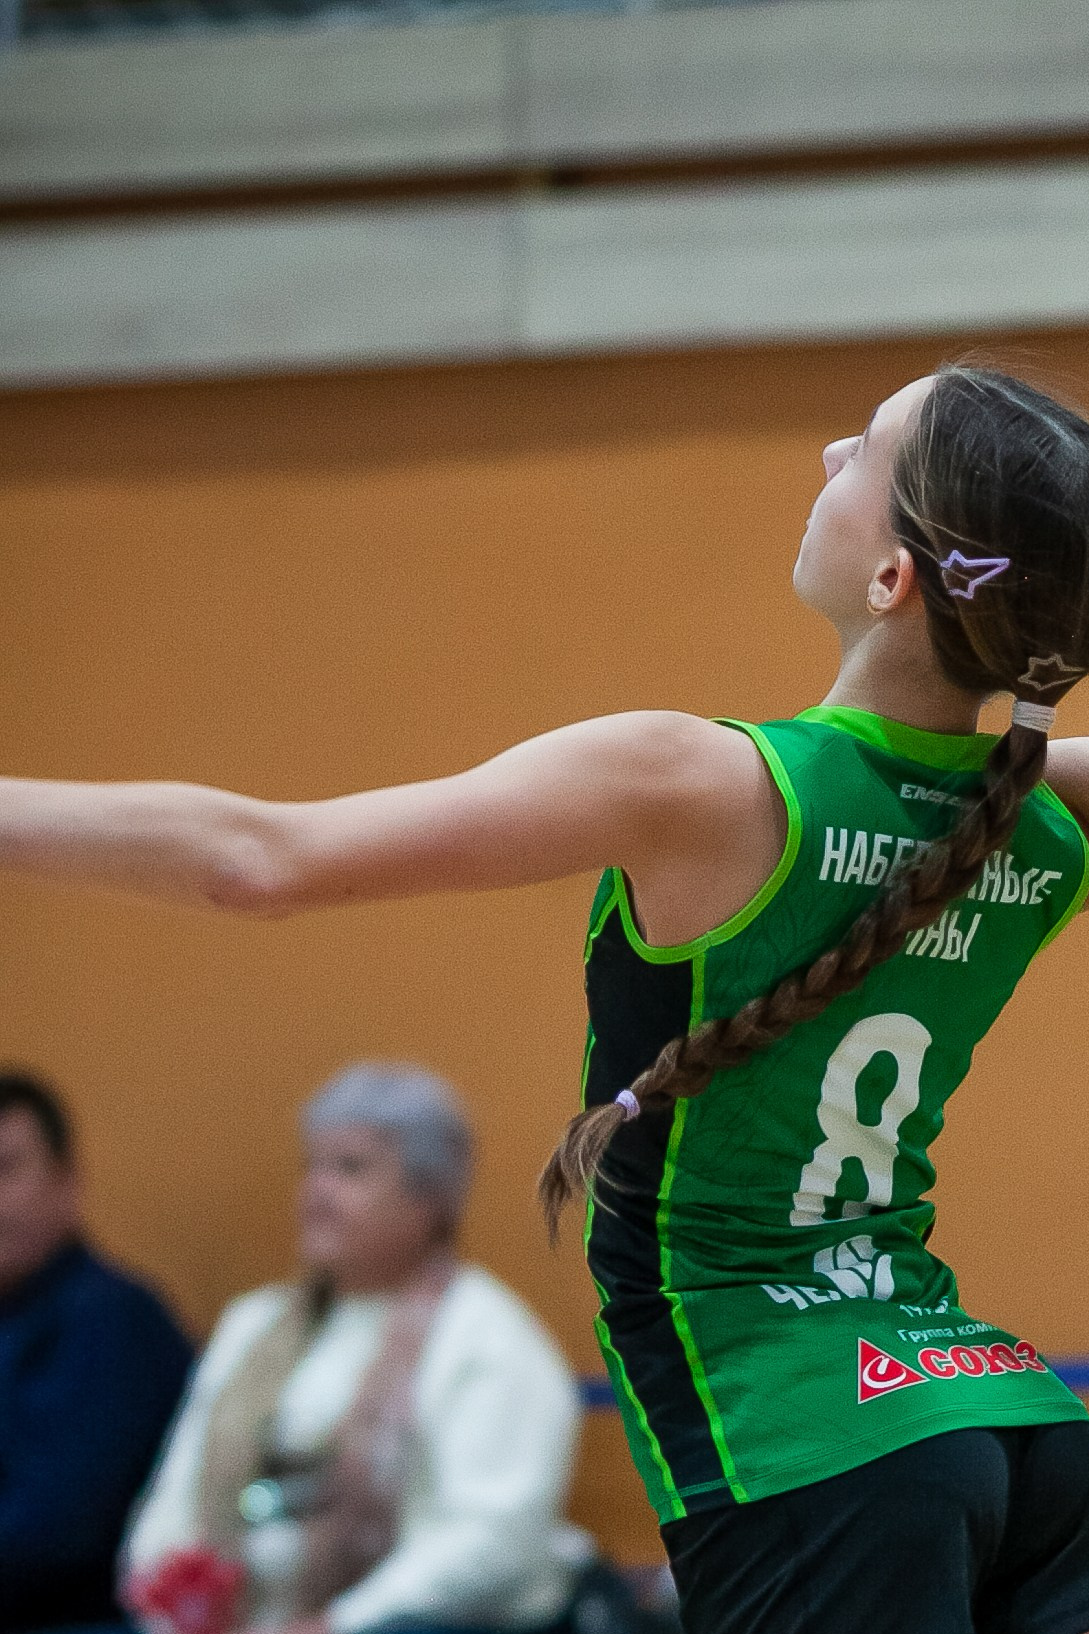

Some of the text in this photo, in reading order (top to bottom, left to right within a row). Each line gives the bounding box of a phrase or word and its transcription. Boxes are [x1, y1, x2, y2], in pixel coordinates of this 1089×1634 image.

[790, 1012, 933, 1227] 8
[896, 1327, 956, 1343] Группа
[917, 1338, 1049, 1380] СОЮЗ
